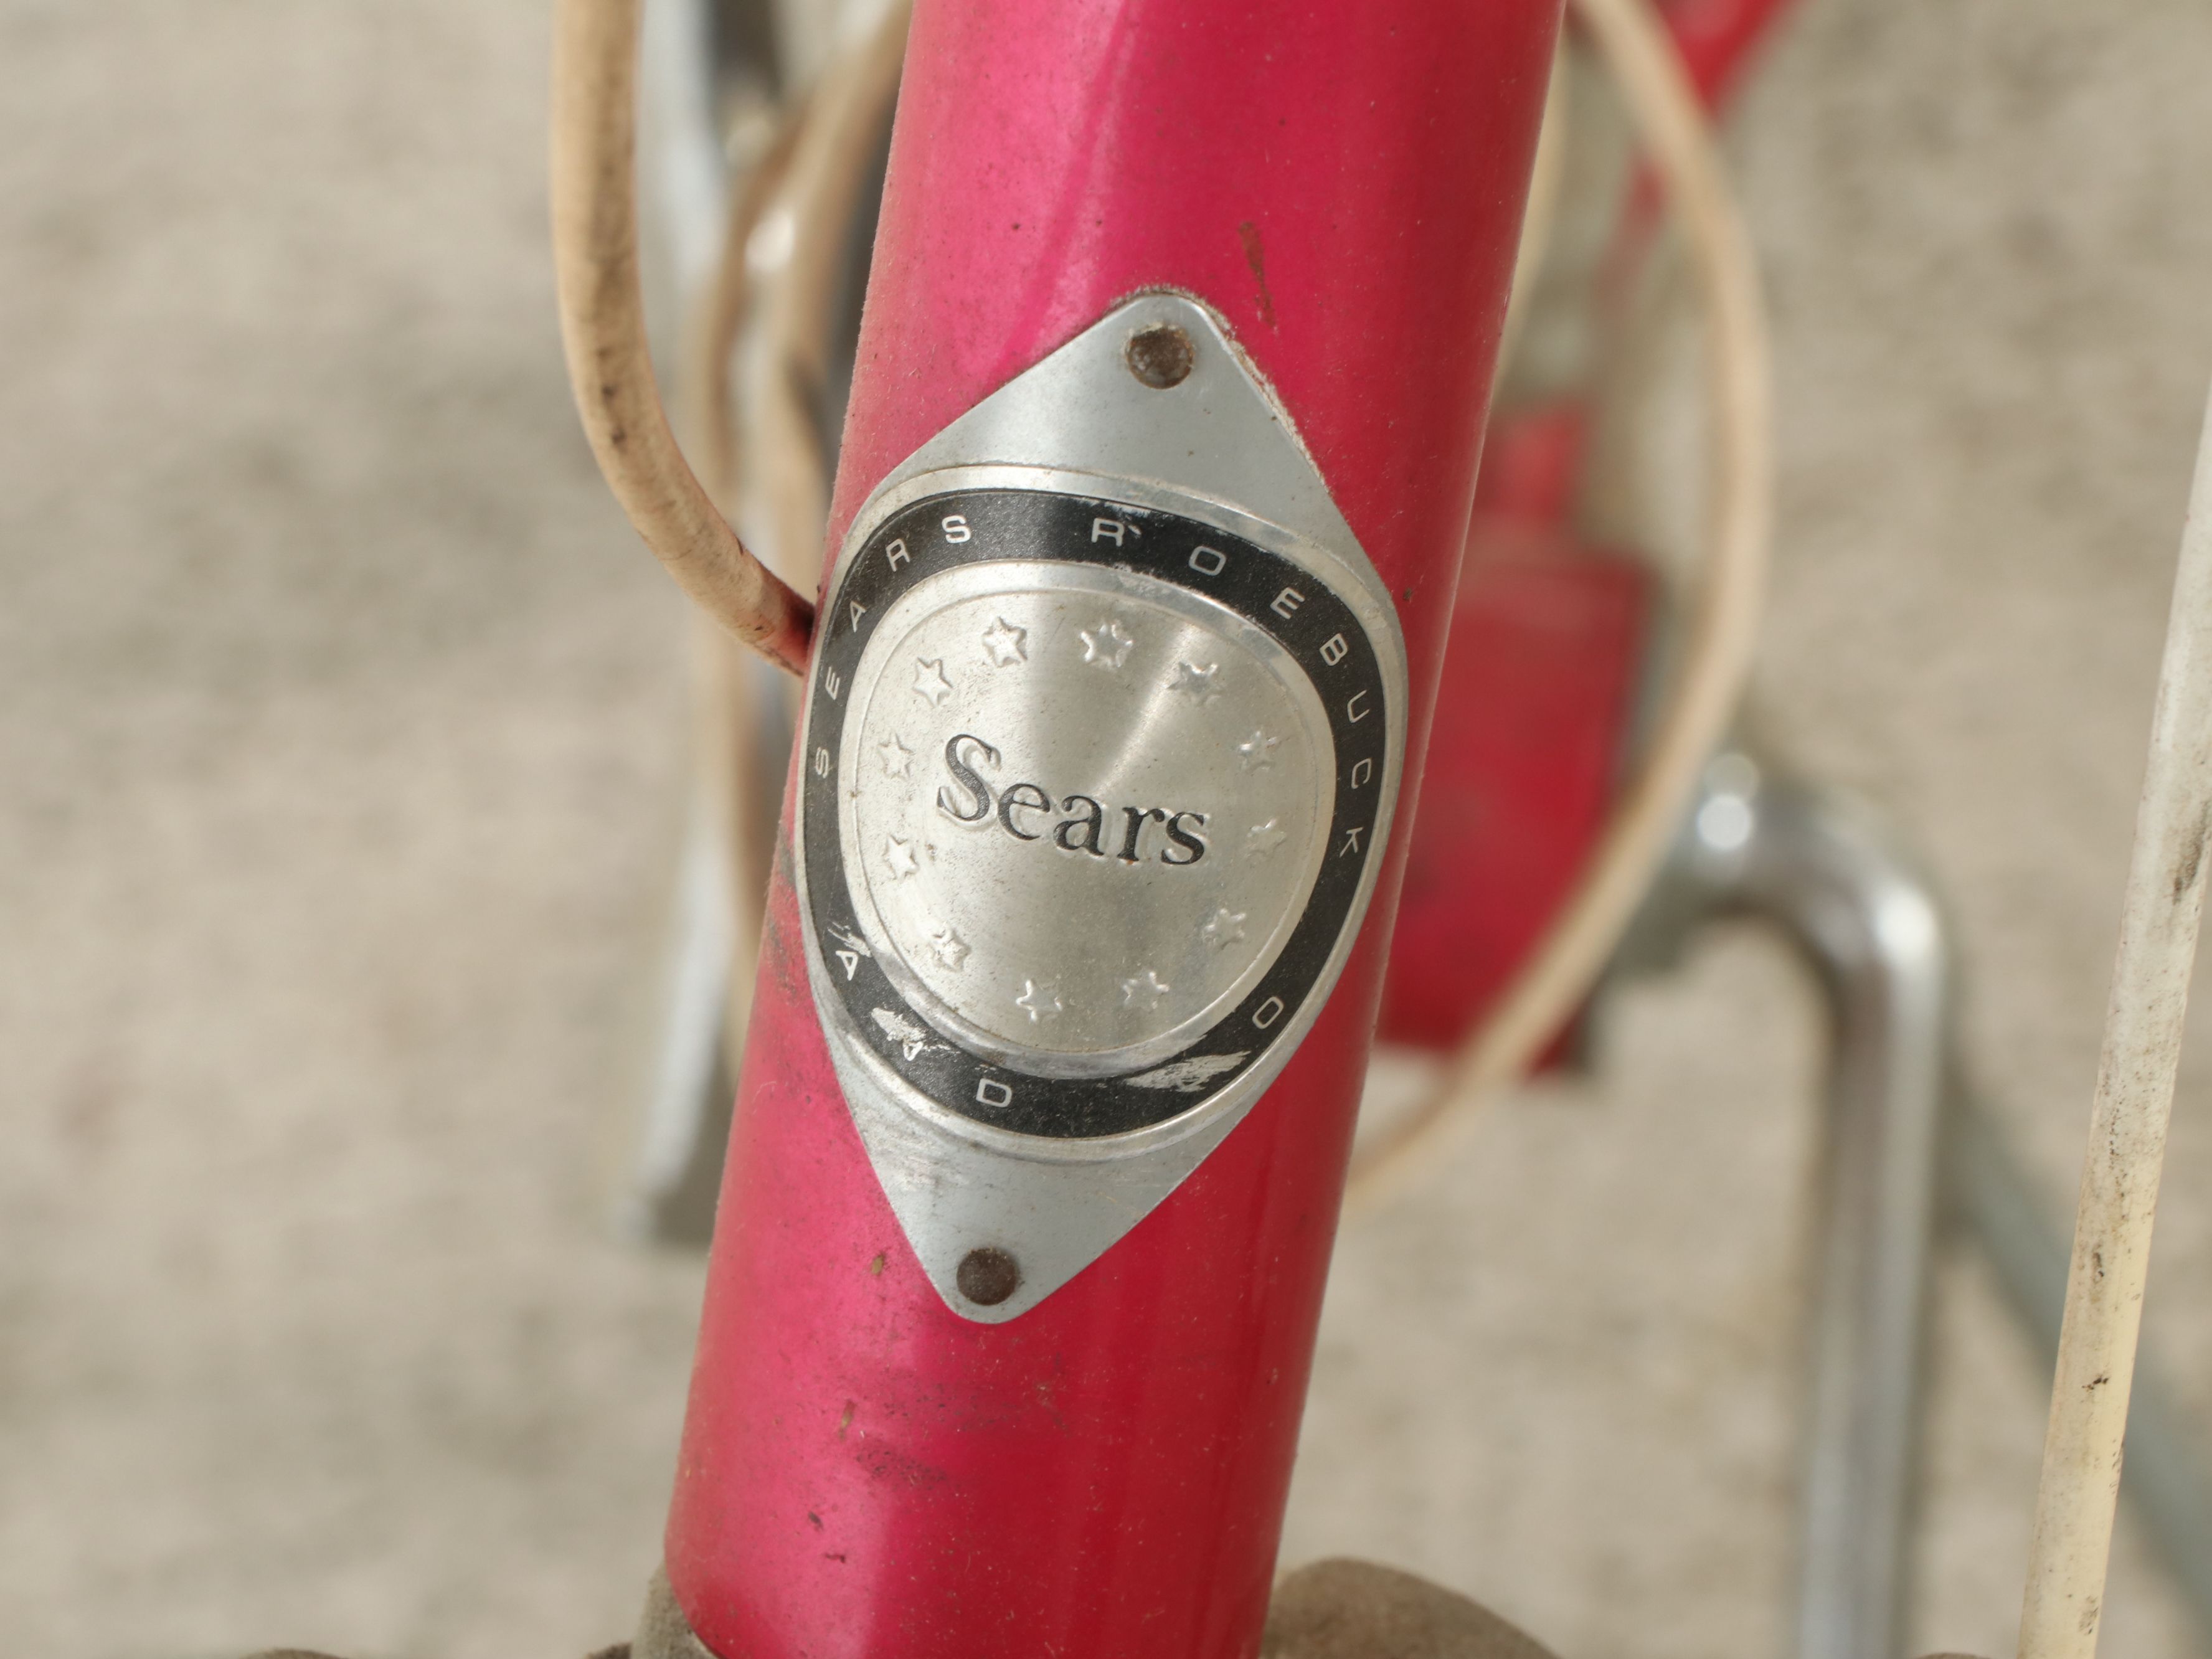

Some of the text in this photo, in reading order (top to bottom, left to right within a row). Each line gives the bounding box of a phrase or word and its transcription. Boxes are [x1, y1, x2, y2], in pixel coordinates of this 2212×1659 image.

[815, 514, 1372, 858] SEARS ROEBUCK
[936, 733, 1206, 866] Sears
